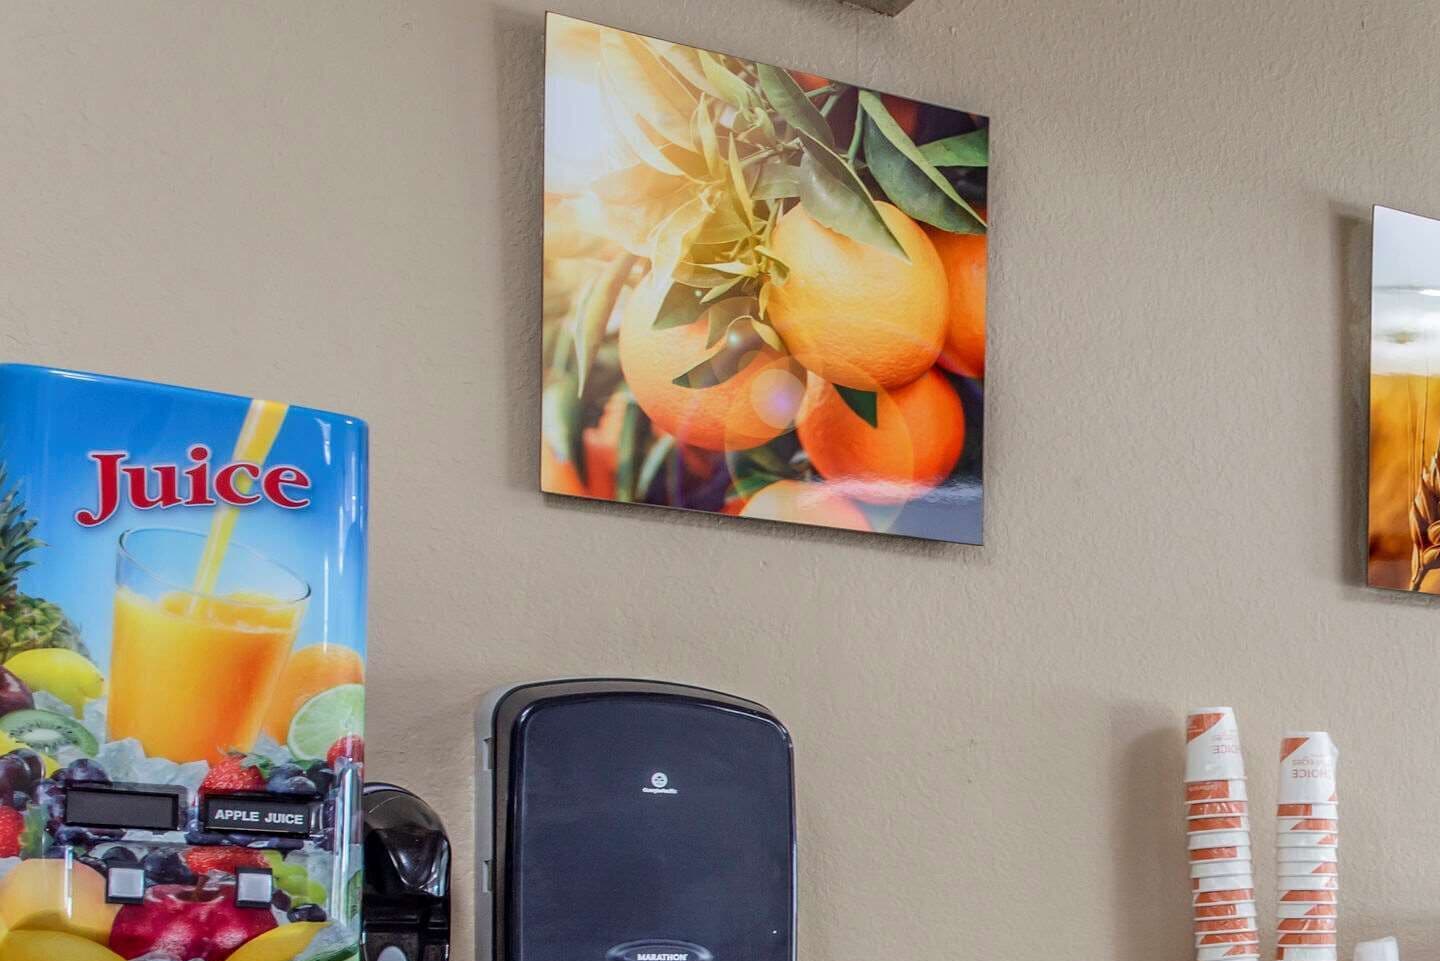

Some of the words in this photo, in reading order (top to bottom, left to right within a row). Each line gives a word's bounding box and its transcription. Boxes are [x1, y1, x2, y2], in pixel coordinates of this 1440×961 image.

[75, 445, 311, 527] Juice
[214, 809, 260, 822] APPLE
[264, 812, 304, 825] JUICE
[636, 953, 688, 961] MARATHON
